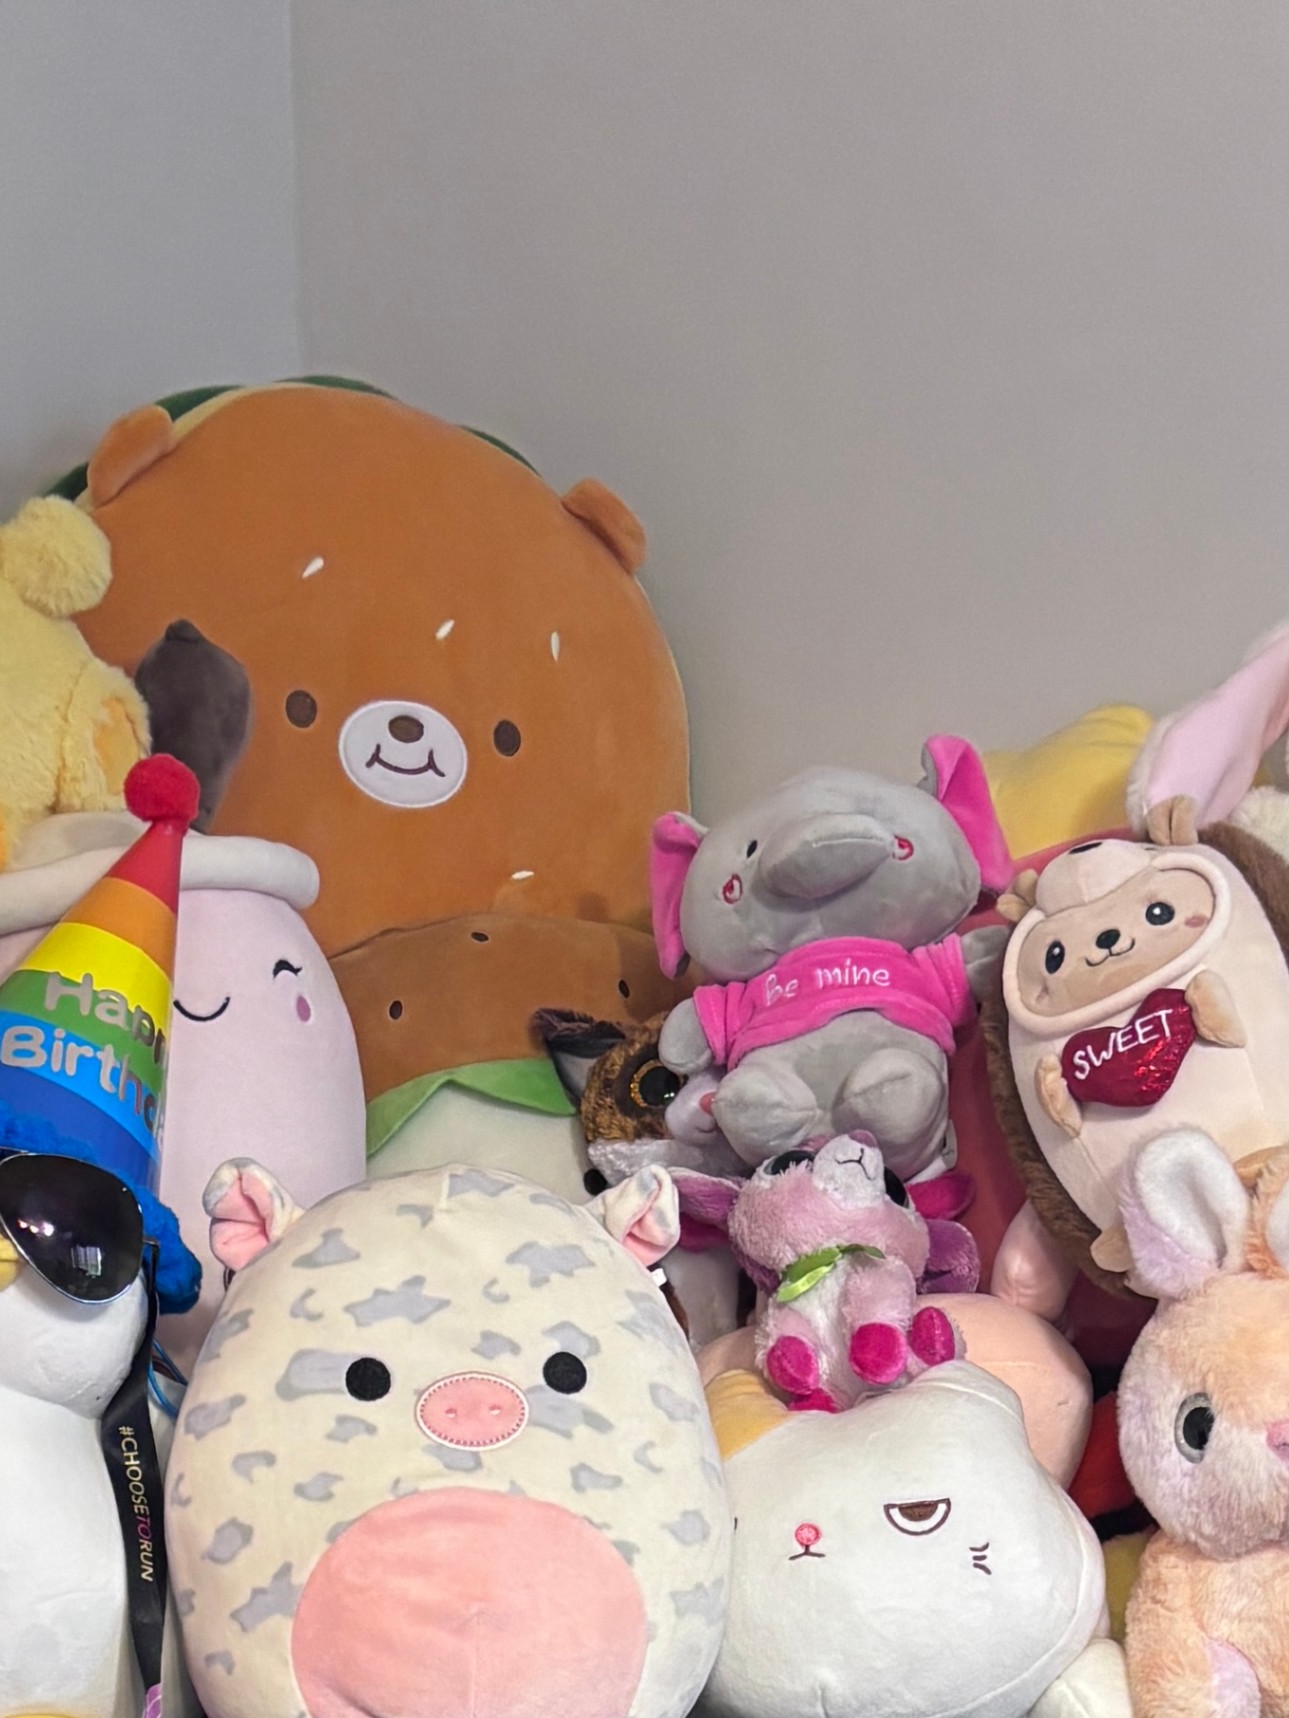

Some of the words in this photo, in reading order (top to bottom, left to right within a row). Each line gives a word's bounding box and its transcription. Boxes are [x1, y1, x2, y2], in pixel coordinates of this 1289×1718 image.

[814, 957, 891, 991] mine
[1072, 1008, 1174, 1081] SWEET
[117, 1425, 154, 1582] #CHOOSETORUN
